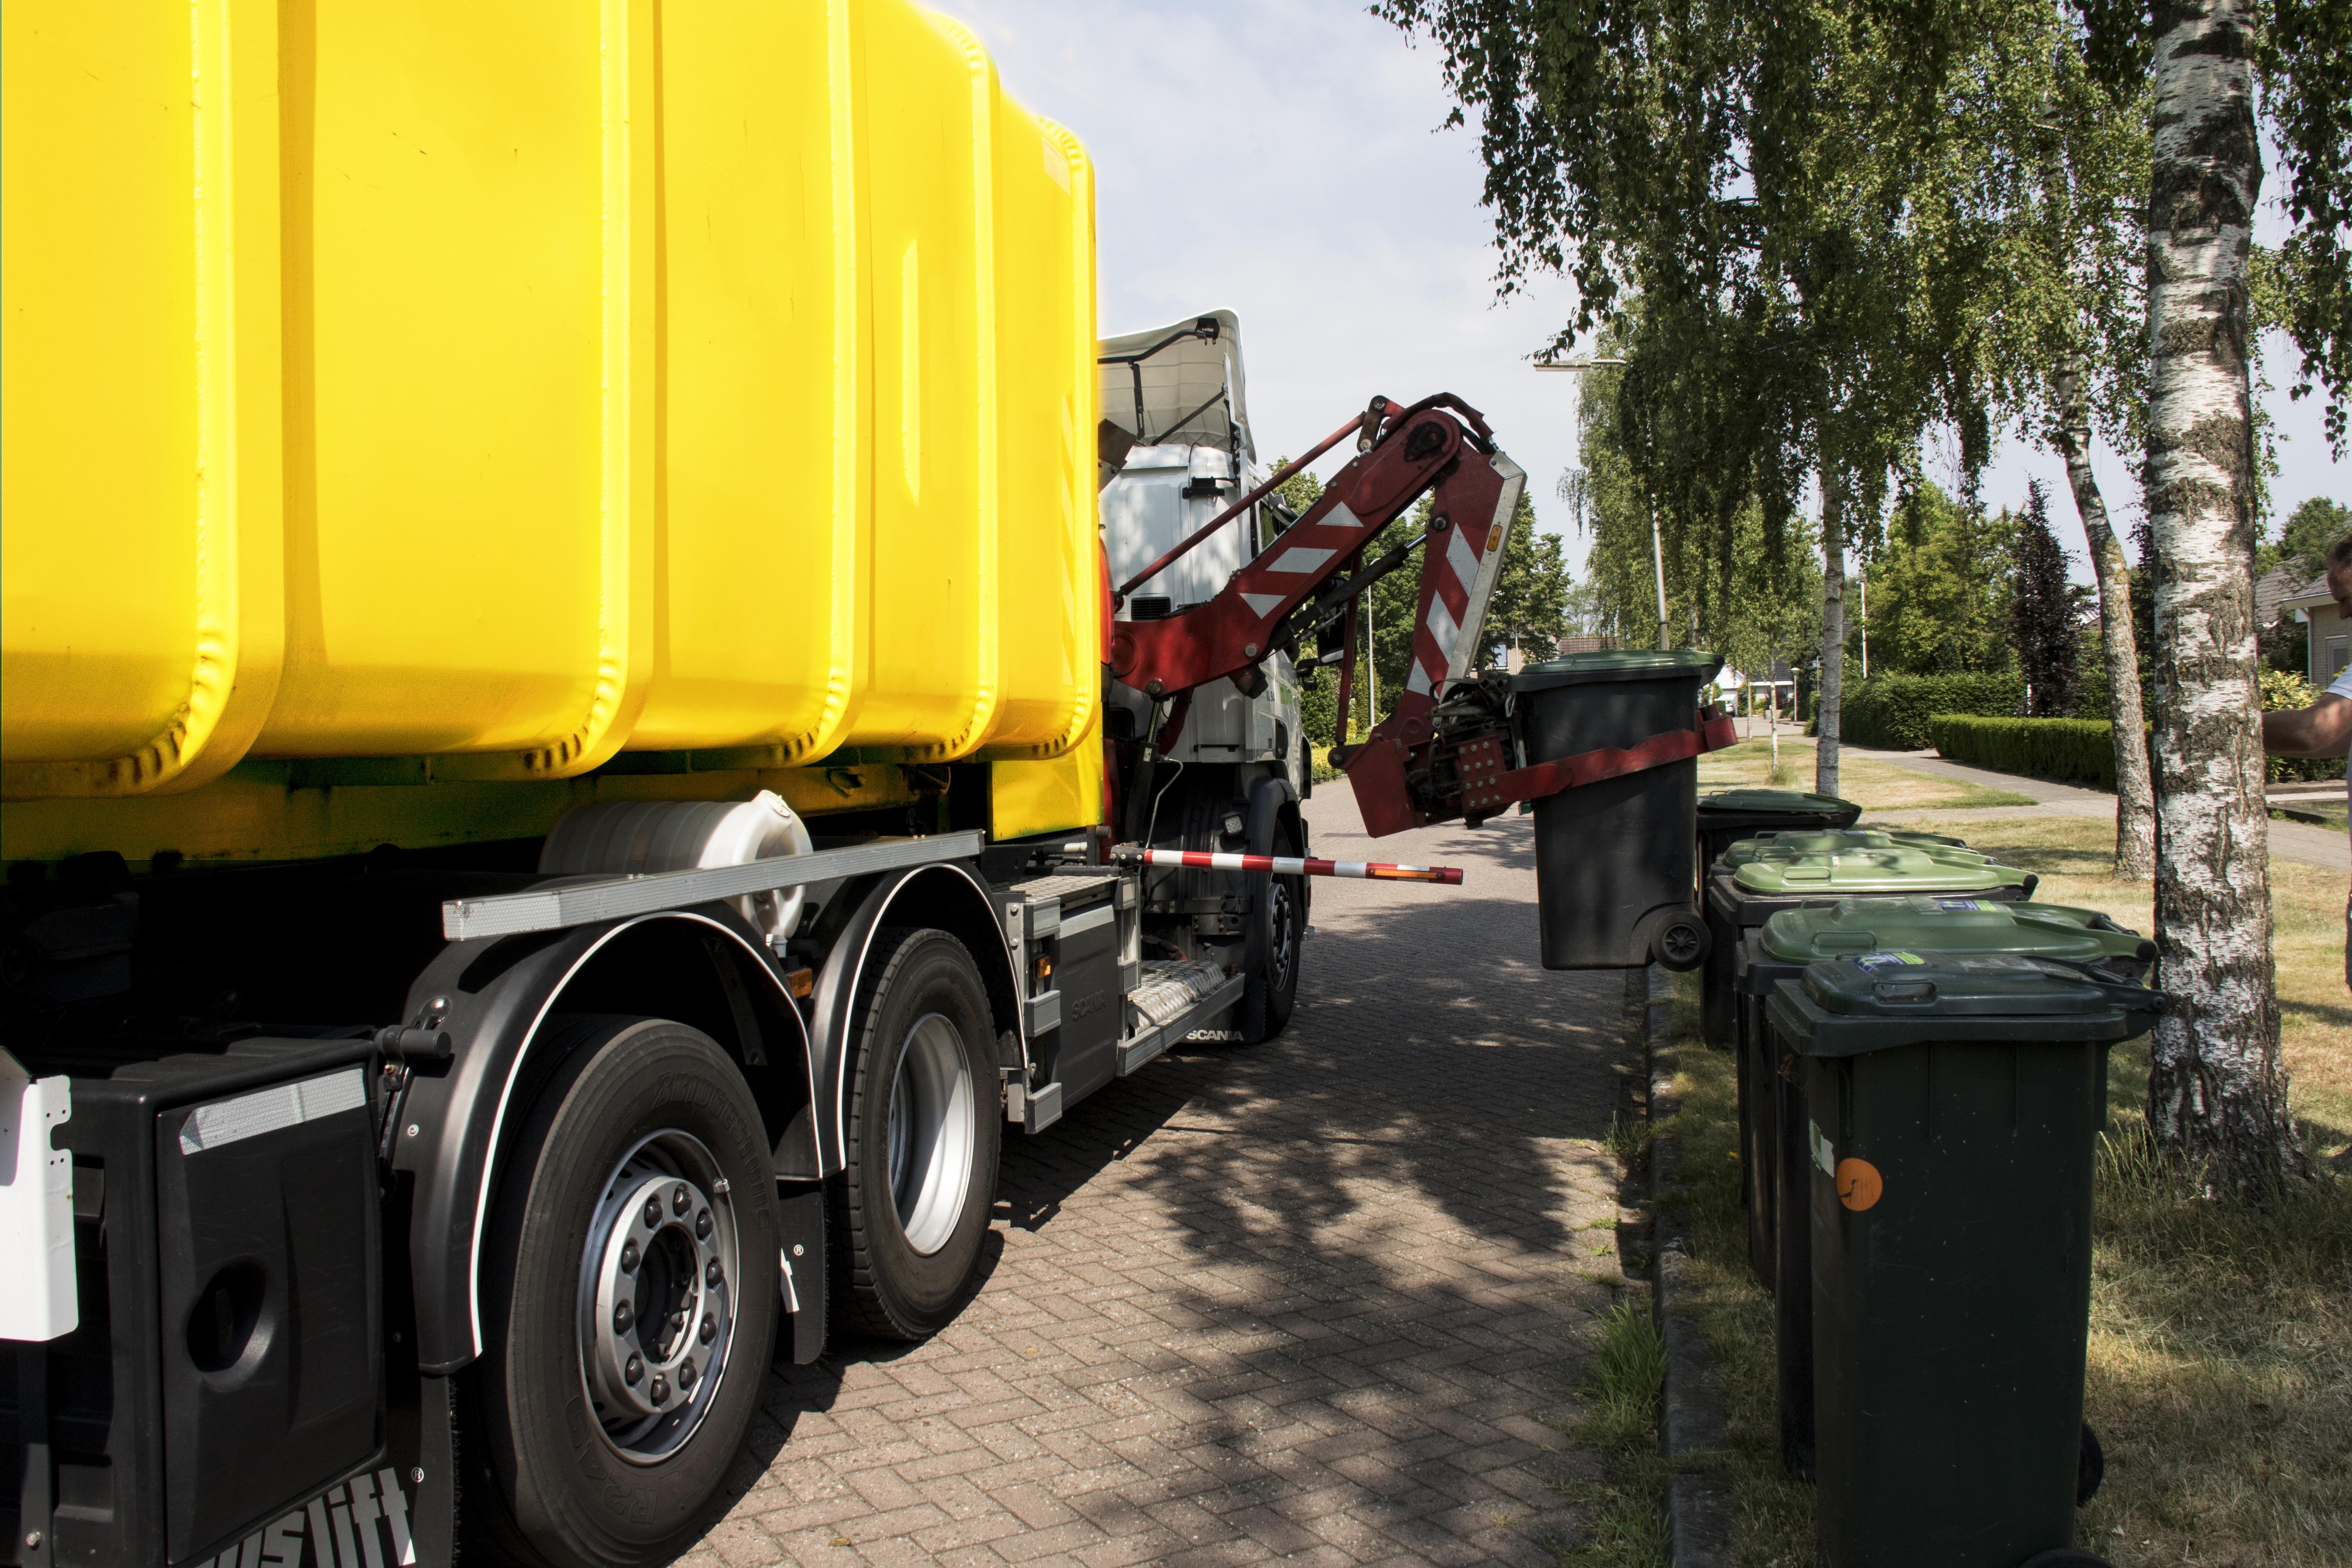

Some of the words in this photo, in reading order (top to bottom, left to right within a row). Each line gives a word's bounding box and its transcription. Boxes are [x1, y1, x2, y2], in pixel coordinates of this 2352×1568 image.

[1072, 990, 1106, 1022] SCANIA
[1186, 1029, 1244, 1041] SCANIA
[652, 1072, 772, 1230] BRIDGESTONE
